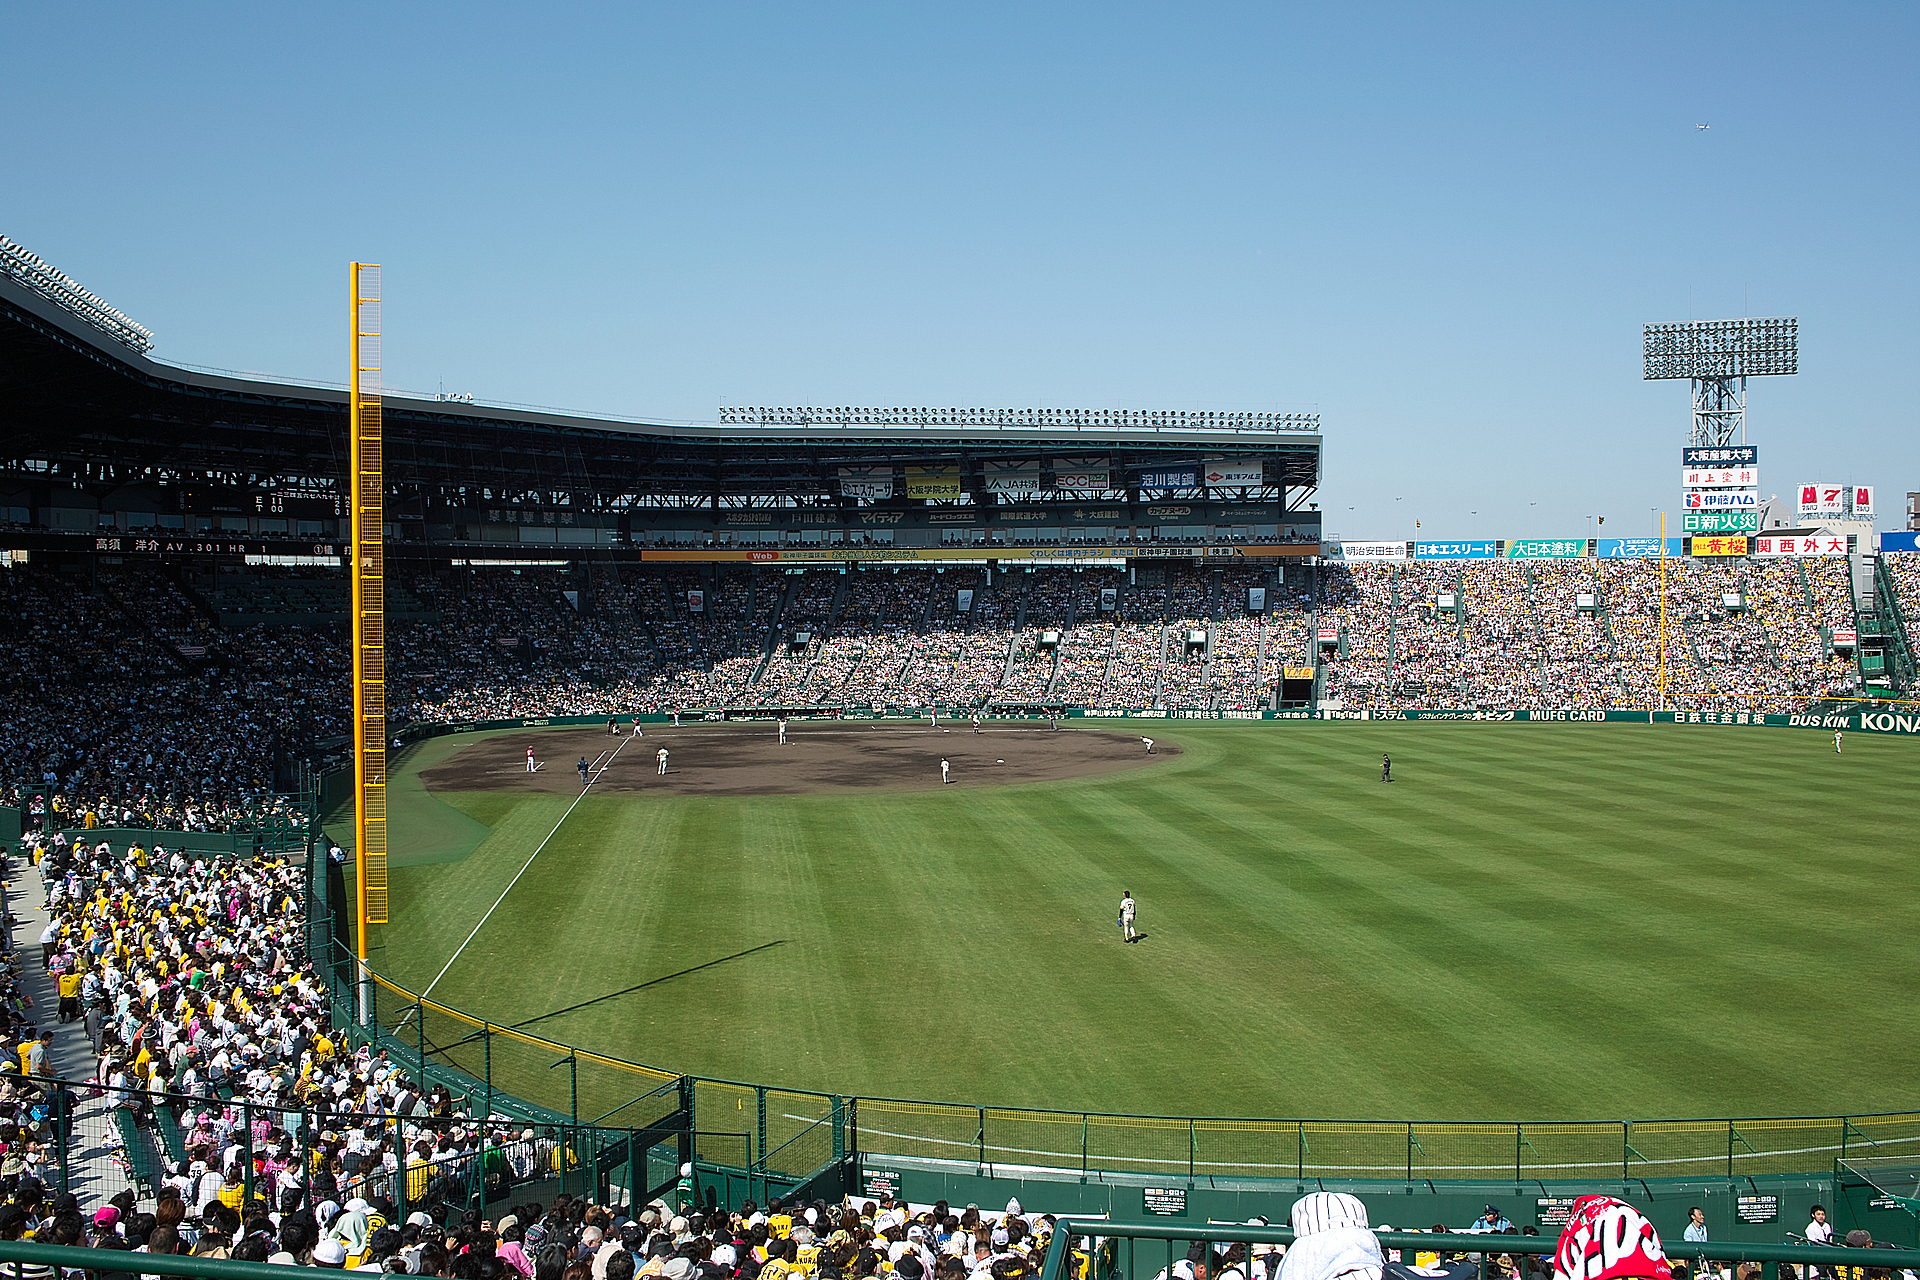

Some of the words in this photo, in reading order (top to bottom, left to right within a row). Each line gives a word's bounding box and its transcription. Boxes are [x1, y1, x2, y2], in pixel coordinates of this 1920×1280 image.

[1688, 448, 1752, 461] 大阪産業大学
[1057, 476, 1088, 486] ECC
[1142, 473, 1194, 487] 淀川製鋼
[1688, 472, 1750, 483] 川上塗料
[908, 484, 959, 494] 大阪学院大学
[1002, 480, 1038, 489] JA共済
[1704, 494, 1755, 506] 伊藤ハム
[255, 504, 264, 512] T
[792, 513, 837, 524] 戸田建設
[1000, 512, 1047, 520] 国際武道大学
[1089, 510, 1120, 518] 大成建設
[1684, 514, 1756, 530] 日新火災
[95, 538, 121, 551] 高須
[136, 540, 160, 552] 洋介
[166, 542, 184, 552] AV
[229, 544, 245, 553] HR
[1346, 545, 1405, 556] 明治安田生命
[1416, 544, 1494, 555] 日本エスリード
[1514, 542, 1578, 556] 大日本塗料
[1756, 538, 1844, 552] 関西外大
[1139, 548, 1192, 556] 阪神甲子園球場
[1373, 710, 1408, 720] トステム
[1530, 710, 1566, 721] MUFG
[1570, 710, 1606, 722] CARD
[1674, 712, 1766, 724] 日鉄住金鋼板
